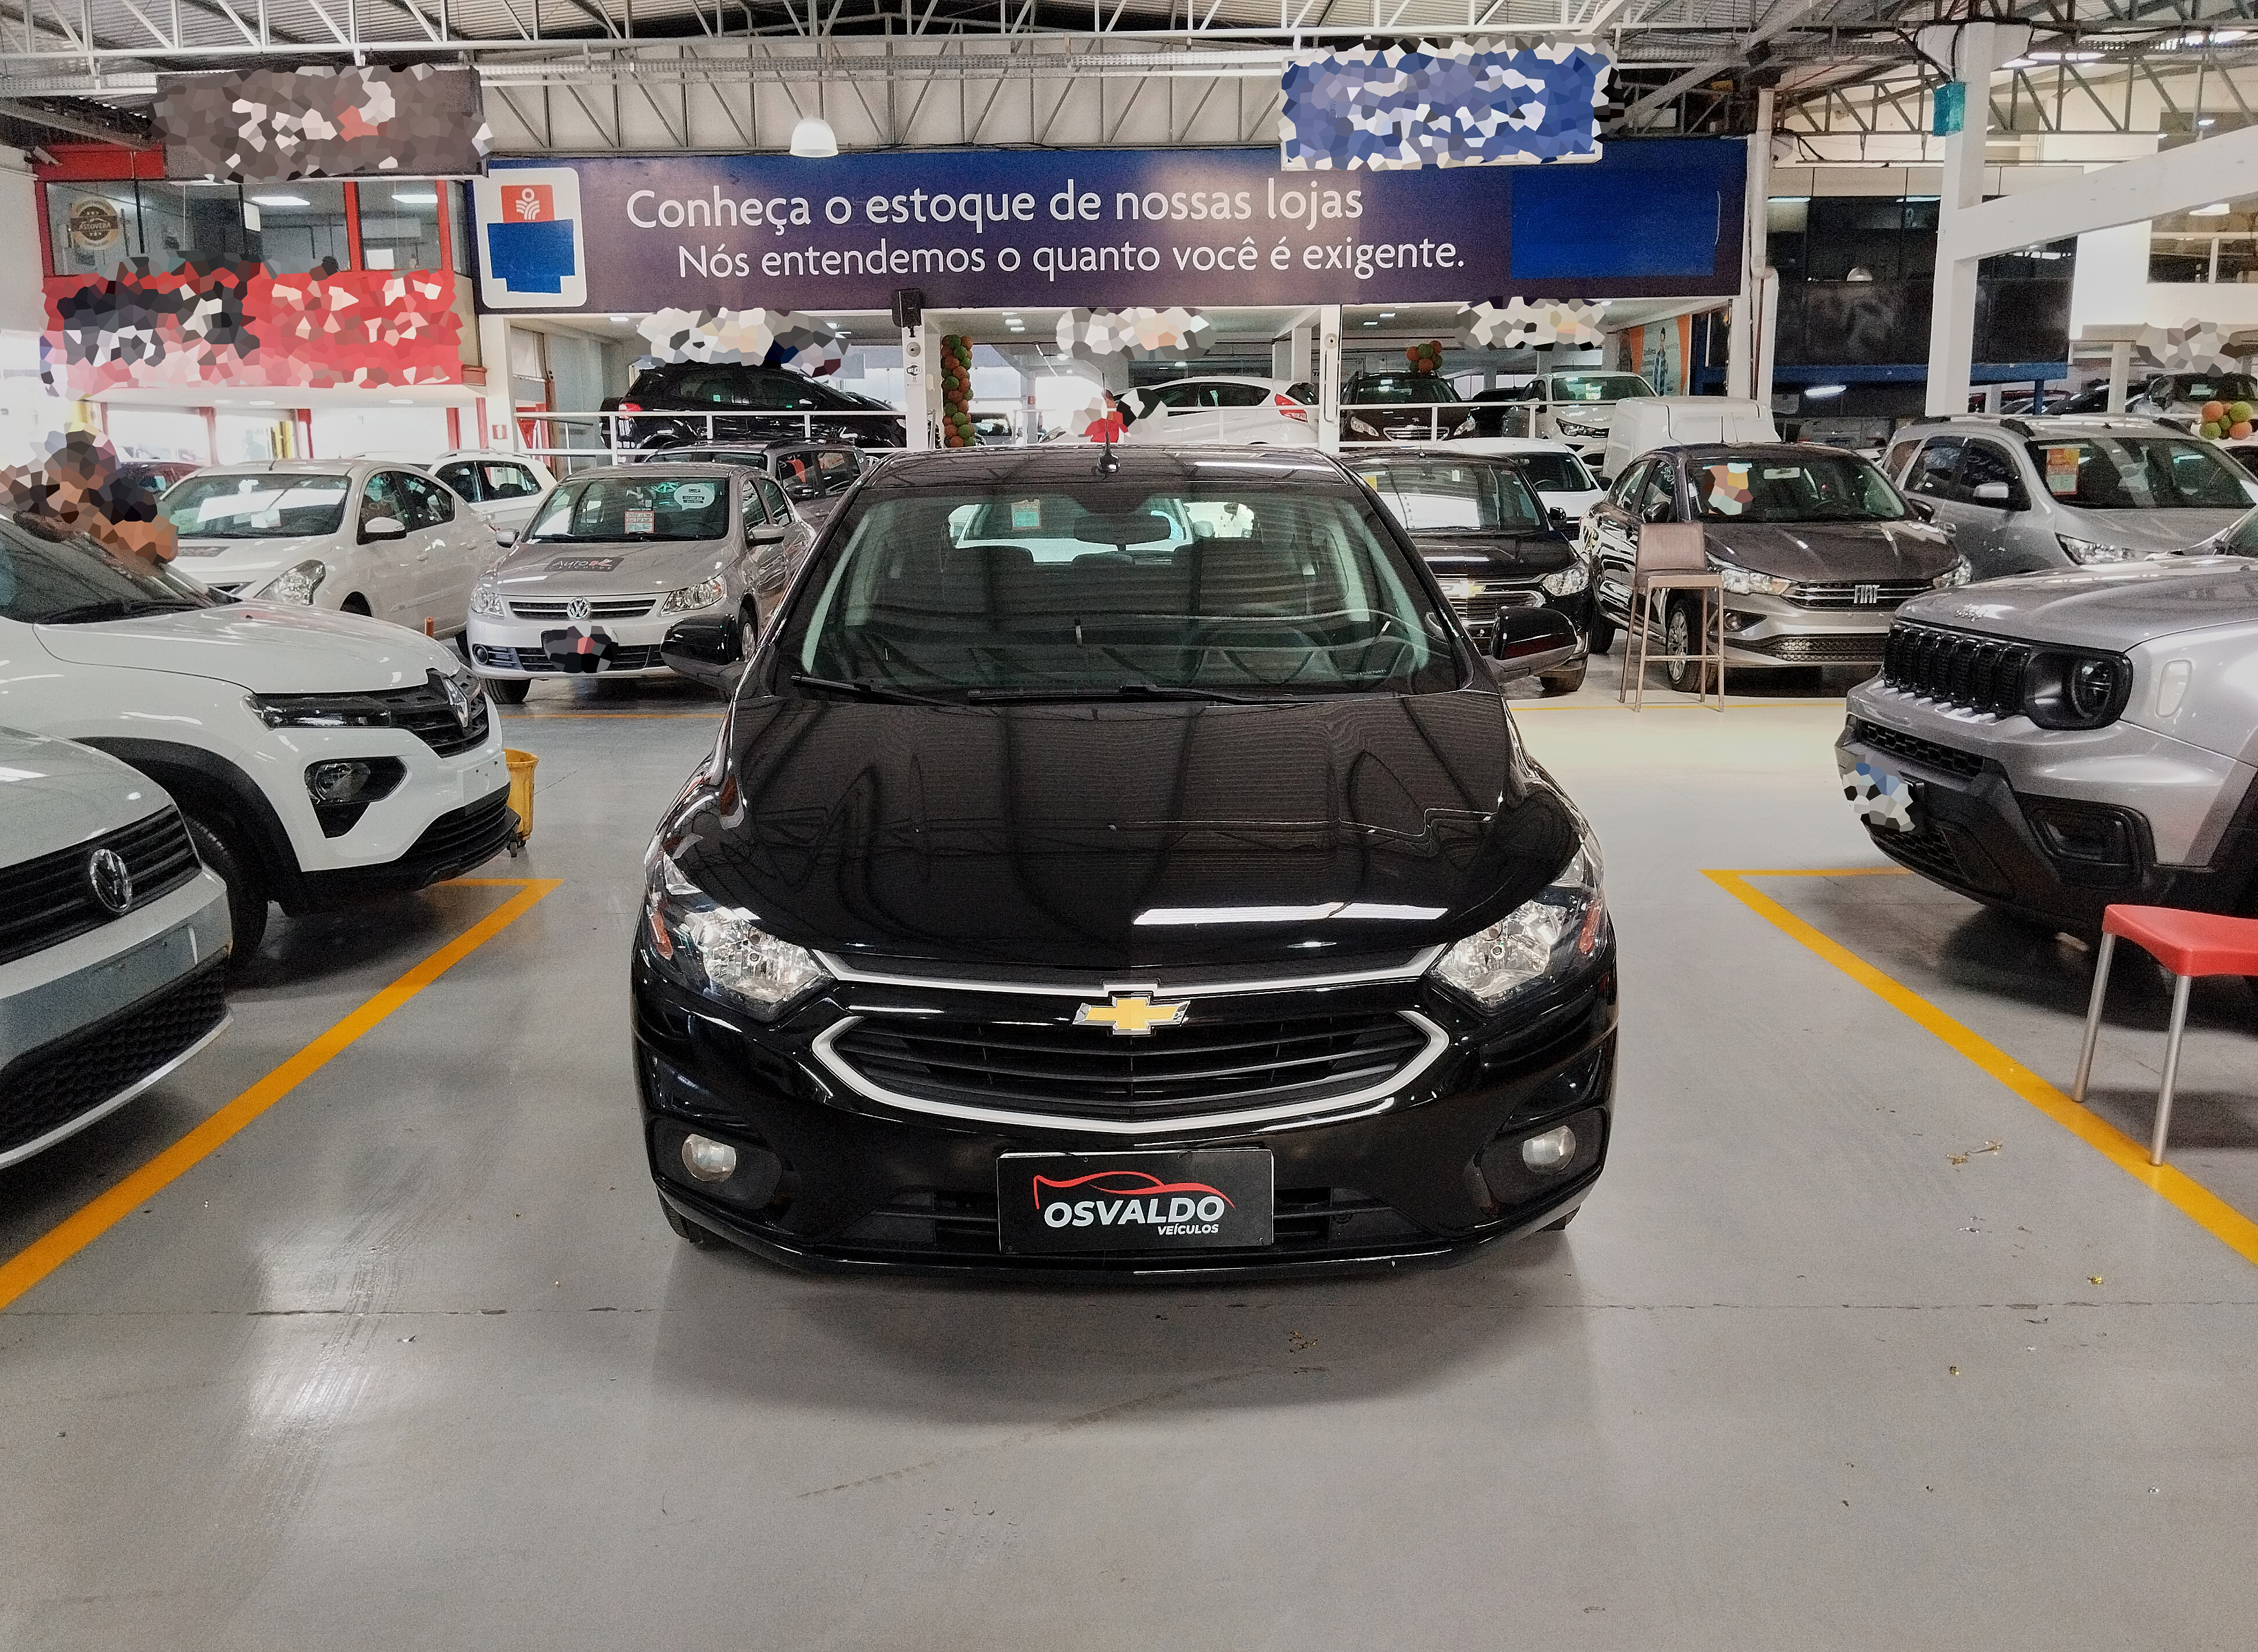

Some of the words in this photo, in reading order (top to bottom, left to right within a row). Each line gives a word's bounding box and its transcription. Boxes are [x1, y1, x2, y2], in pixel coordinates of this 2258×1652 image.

[627, 186, 812, 236] Conheça
[826, 196, 852, 224] o
[866, 187, 1035, 234] estoque
[1050, 178, 1101, 221] de
[1116, 192, 1252, 221] nossas
[1268, 177, 1363, 231] lojas
[679, 243, 750, 278] Nós
[761, 237, 986, 277] entendemos
[997, 247, 1021, 272] o
[1033, 241, 1160, 282] quanto
[1172, 236, 1258, 272] você
[1270, 235, 1291, 270] é
[1303, 236, 1464, 279] exigente.
[1853, 584, 1880, 604] FIAT
[1044, 1195, 1225, 1228] OSVALDO
[1157, 1223, 1219, 1235] VEÍCULOS
